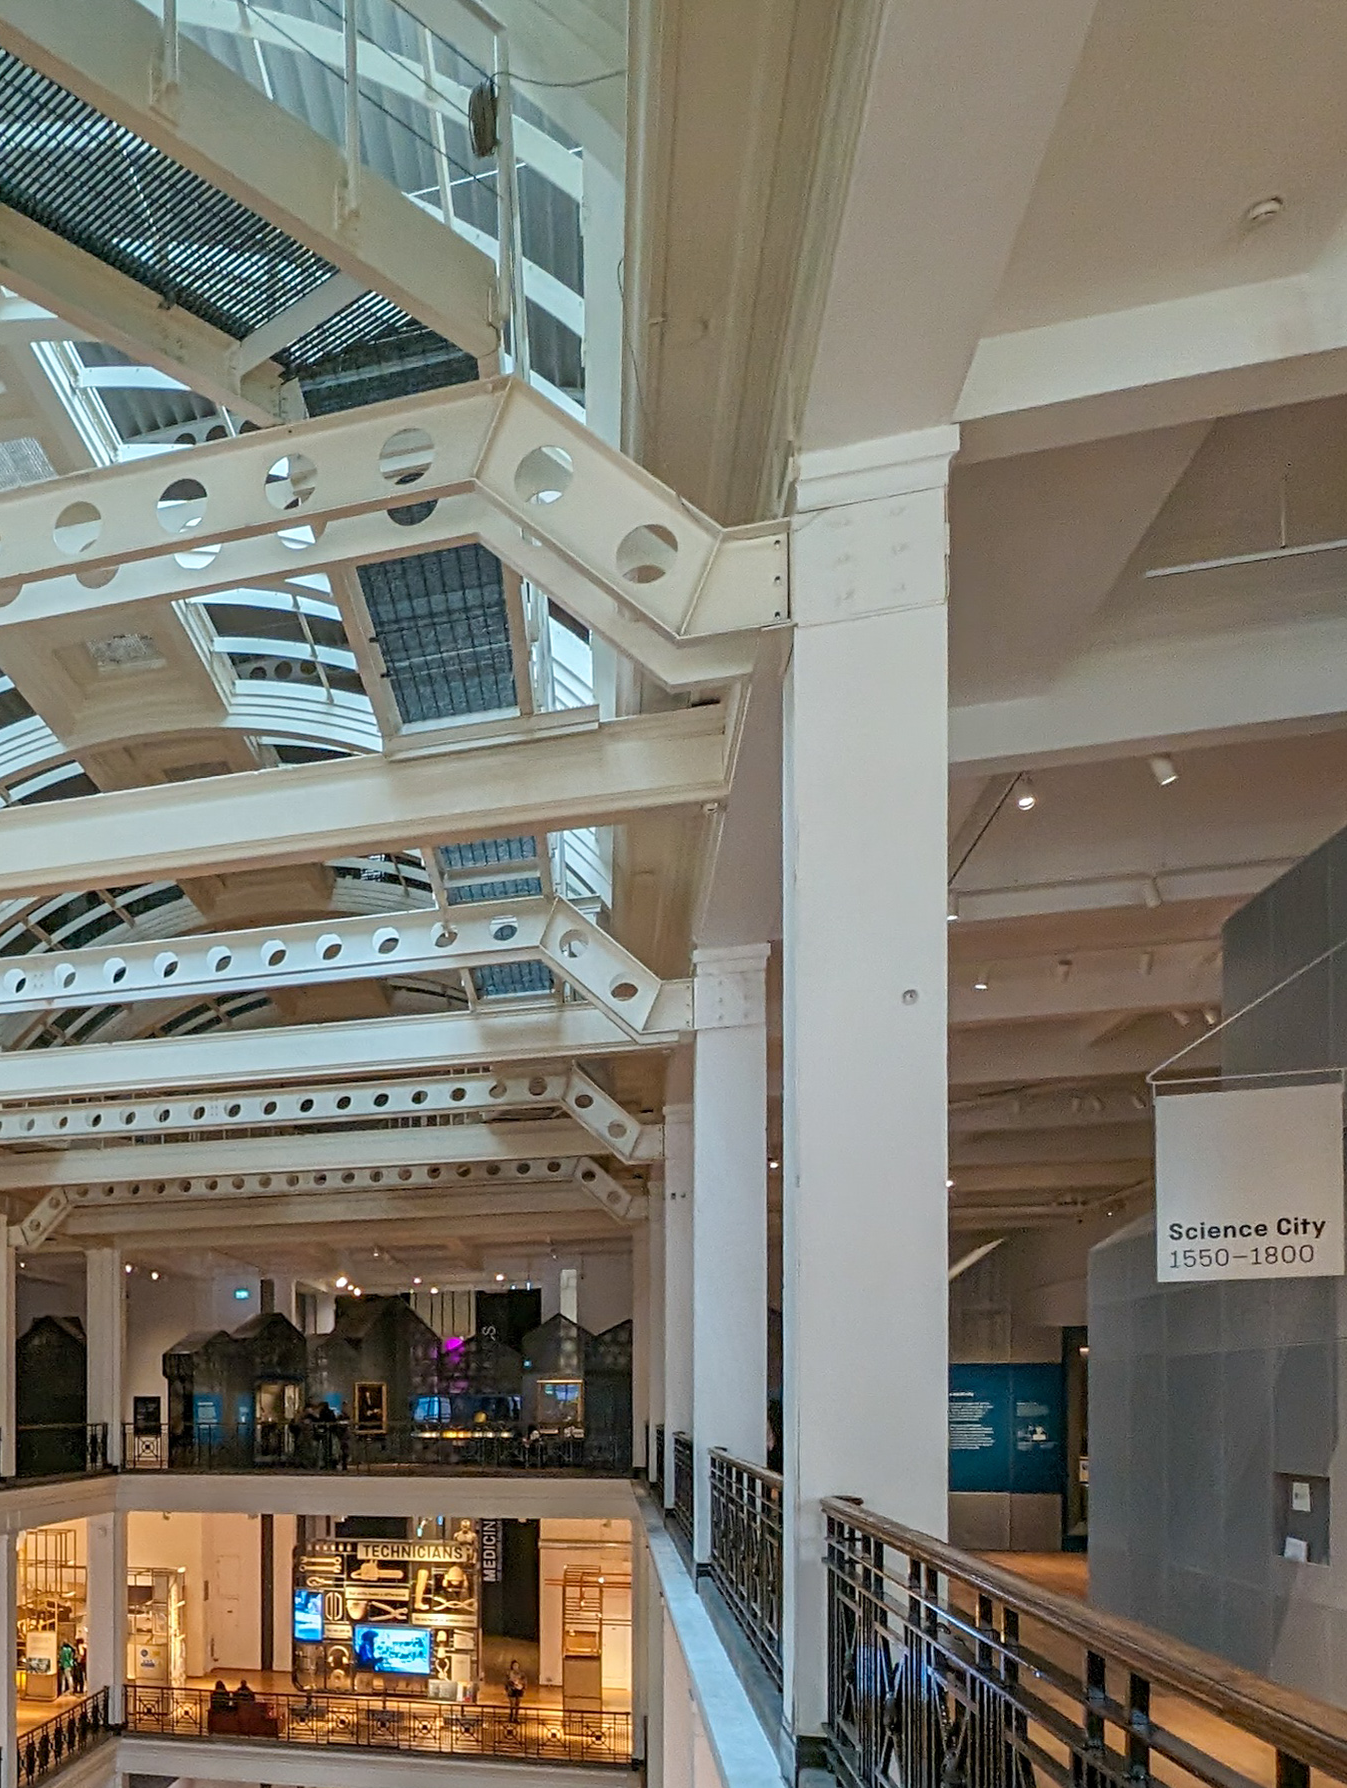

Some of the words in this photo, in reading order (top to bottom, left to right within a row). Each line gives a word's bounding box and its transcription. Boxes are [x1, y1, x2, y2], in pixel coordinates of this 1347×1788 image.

[1169, 1222, 1268, 1241] Science
[1277, 1217, 1326, 1239] City
[363, 1544, 463, 1560] TECHNICIANS
